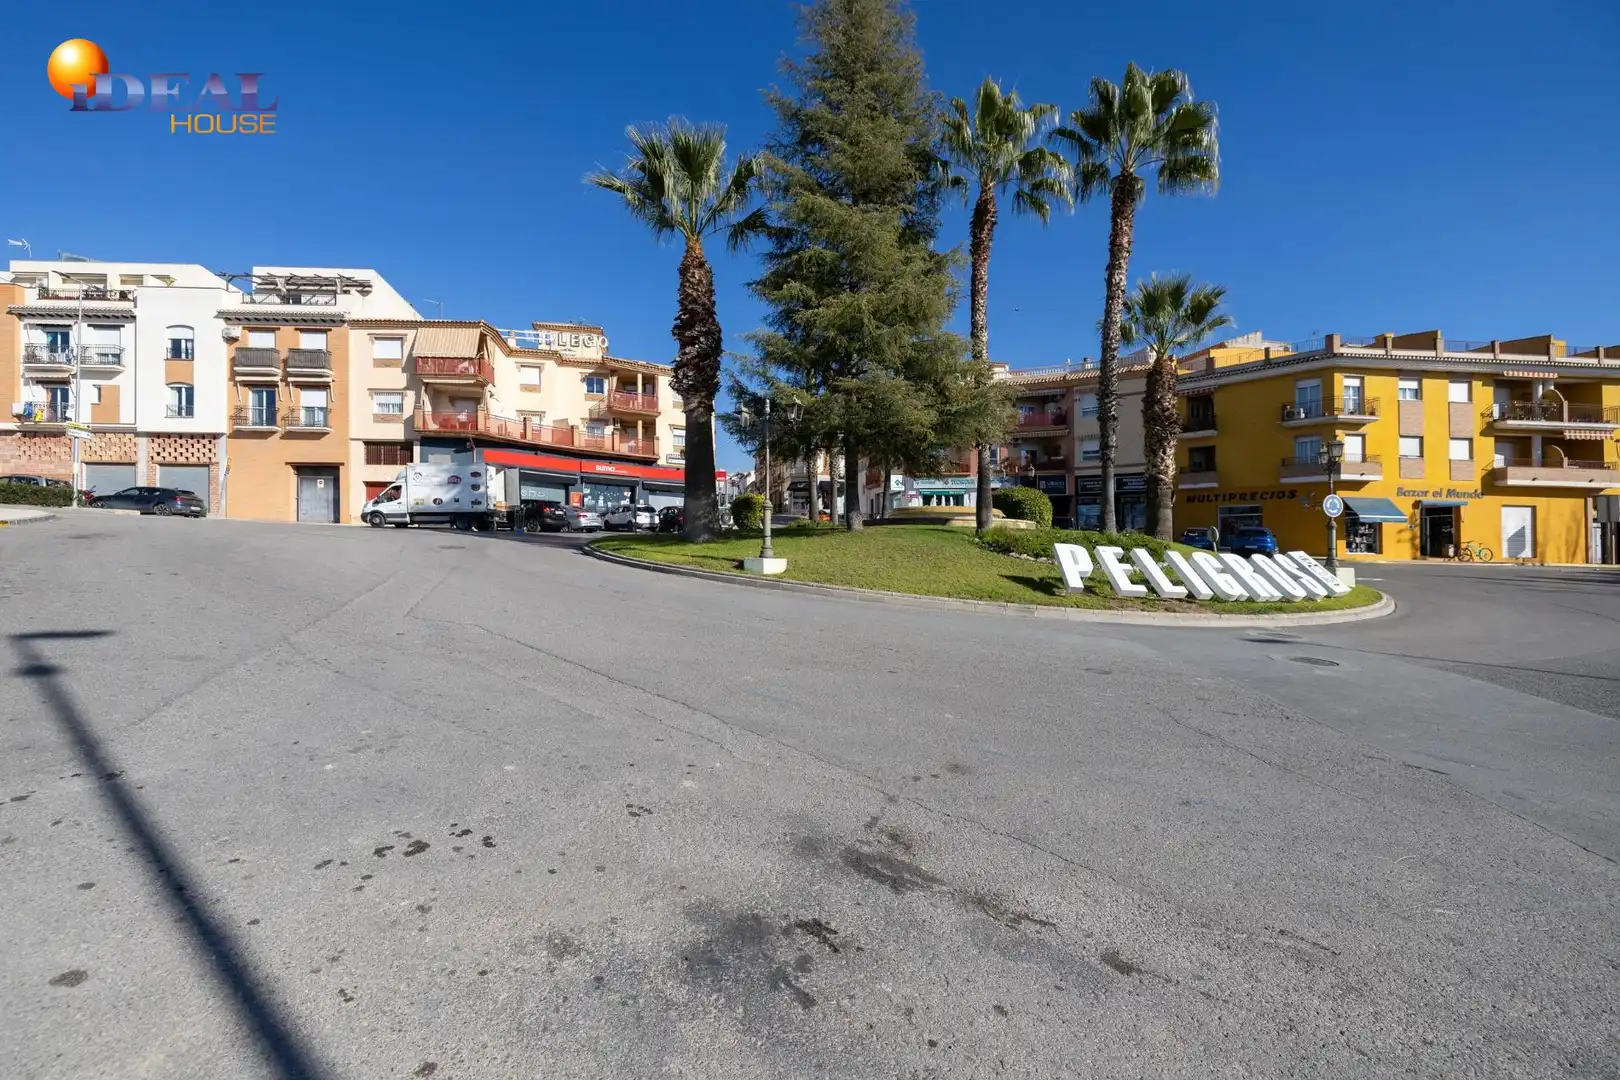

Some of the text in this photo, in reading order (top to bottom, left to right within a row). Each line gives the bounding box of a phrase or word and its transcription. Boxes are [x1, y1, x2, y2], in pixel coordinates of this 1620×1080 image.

[1186, 488, 1299, 504] MULTIPRECIOS
[1396, 486, 1485, 500] Bazar el Mundo
[1053, 542, 1329, 602] PELIGROS
